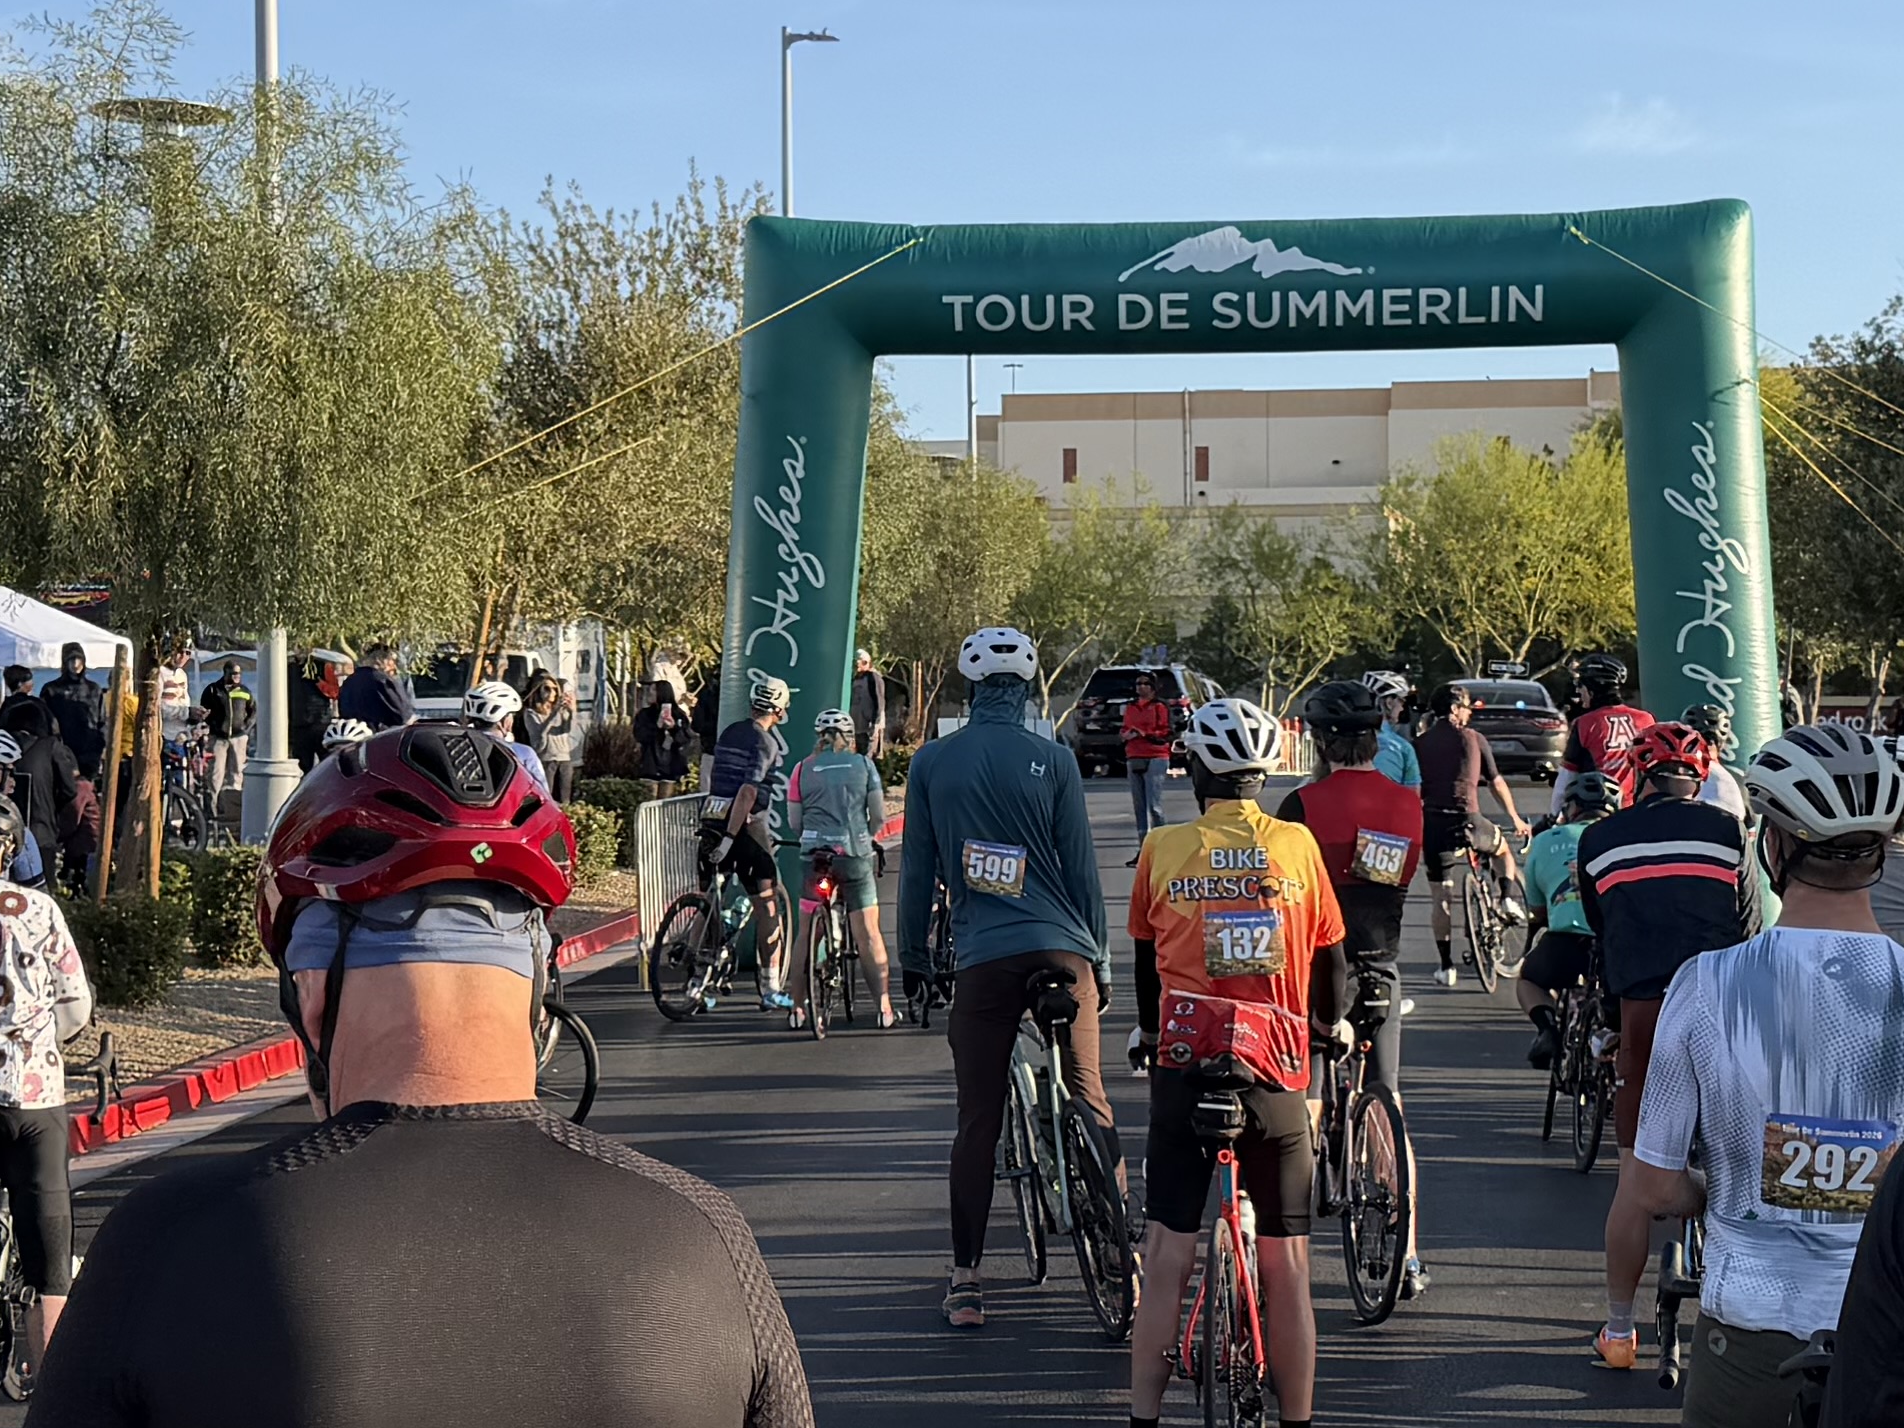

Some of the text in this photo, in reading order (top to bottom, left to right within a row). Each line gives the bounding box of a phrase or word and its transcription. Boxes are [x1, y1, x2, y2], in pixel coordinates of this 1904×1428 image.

[942, 284, 1545, 332] TOUR DE SUMMERLIN
[967, 852, 1017, 884] 599
[1210, 846, 1269, 870] BIKE
[1361, 842, 1402, 873] 463
[1167, 876, 1306, 906] PRESCOTT
[1217, 925, 1273, 961] 132
[1779, 1140, 1878, 1191] 292
